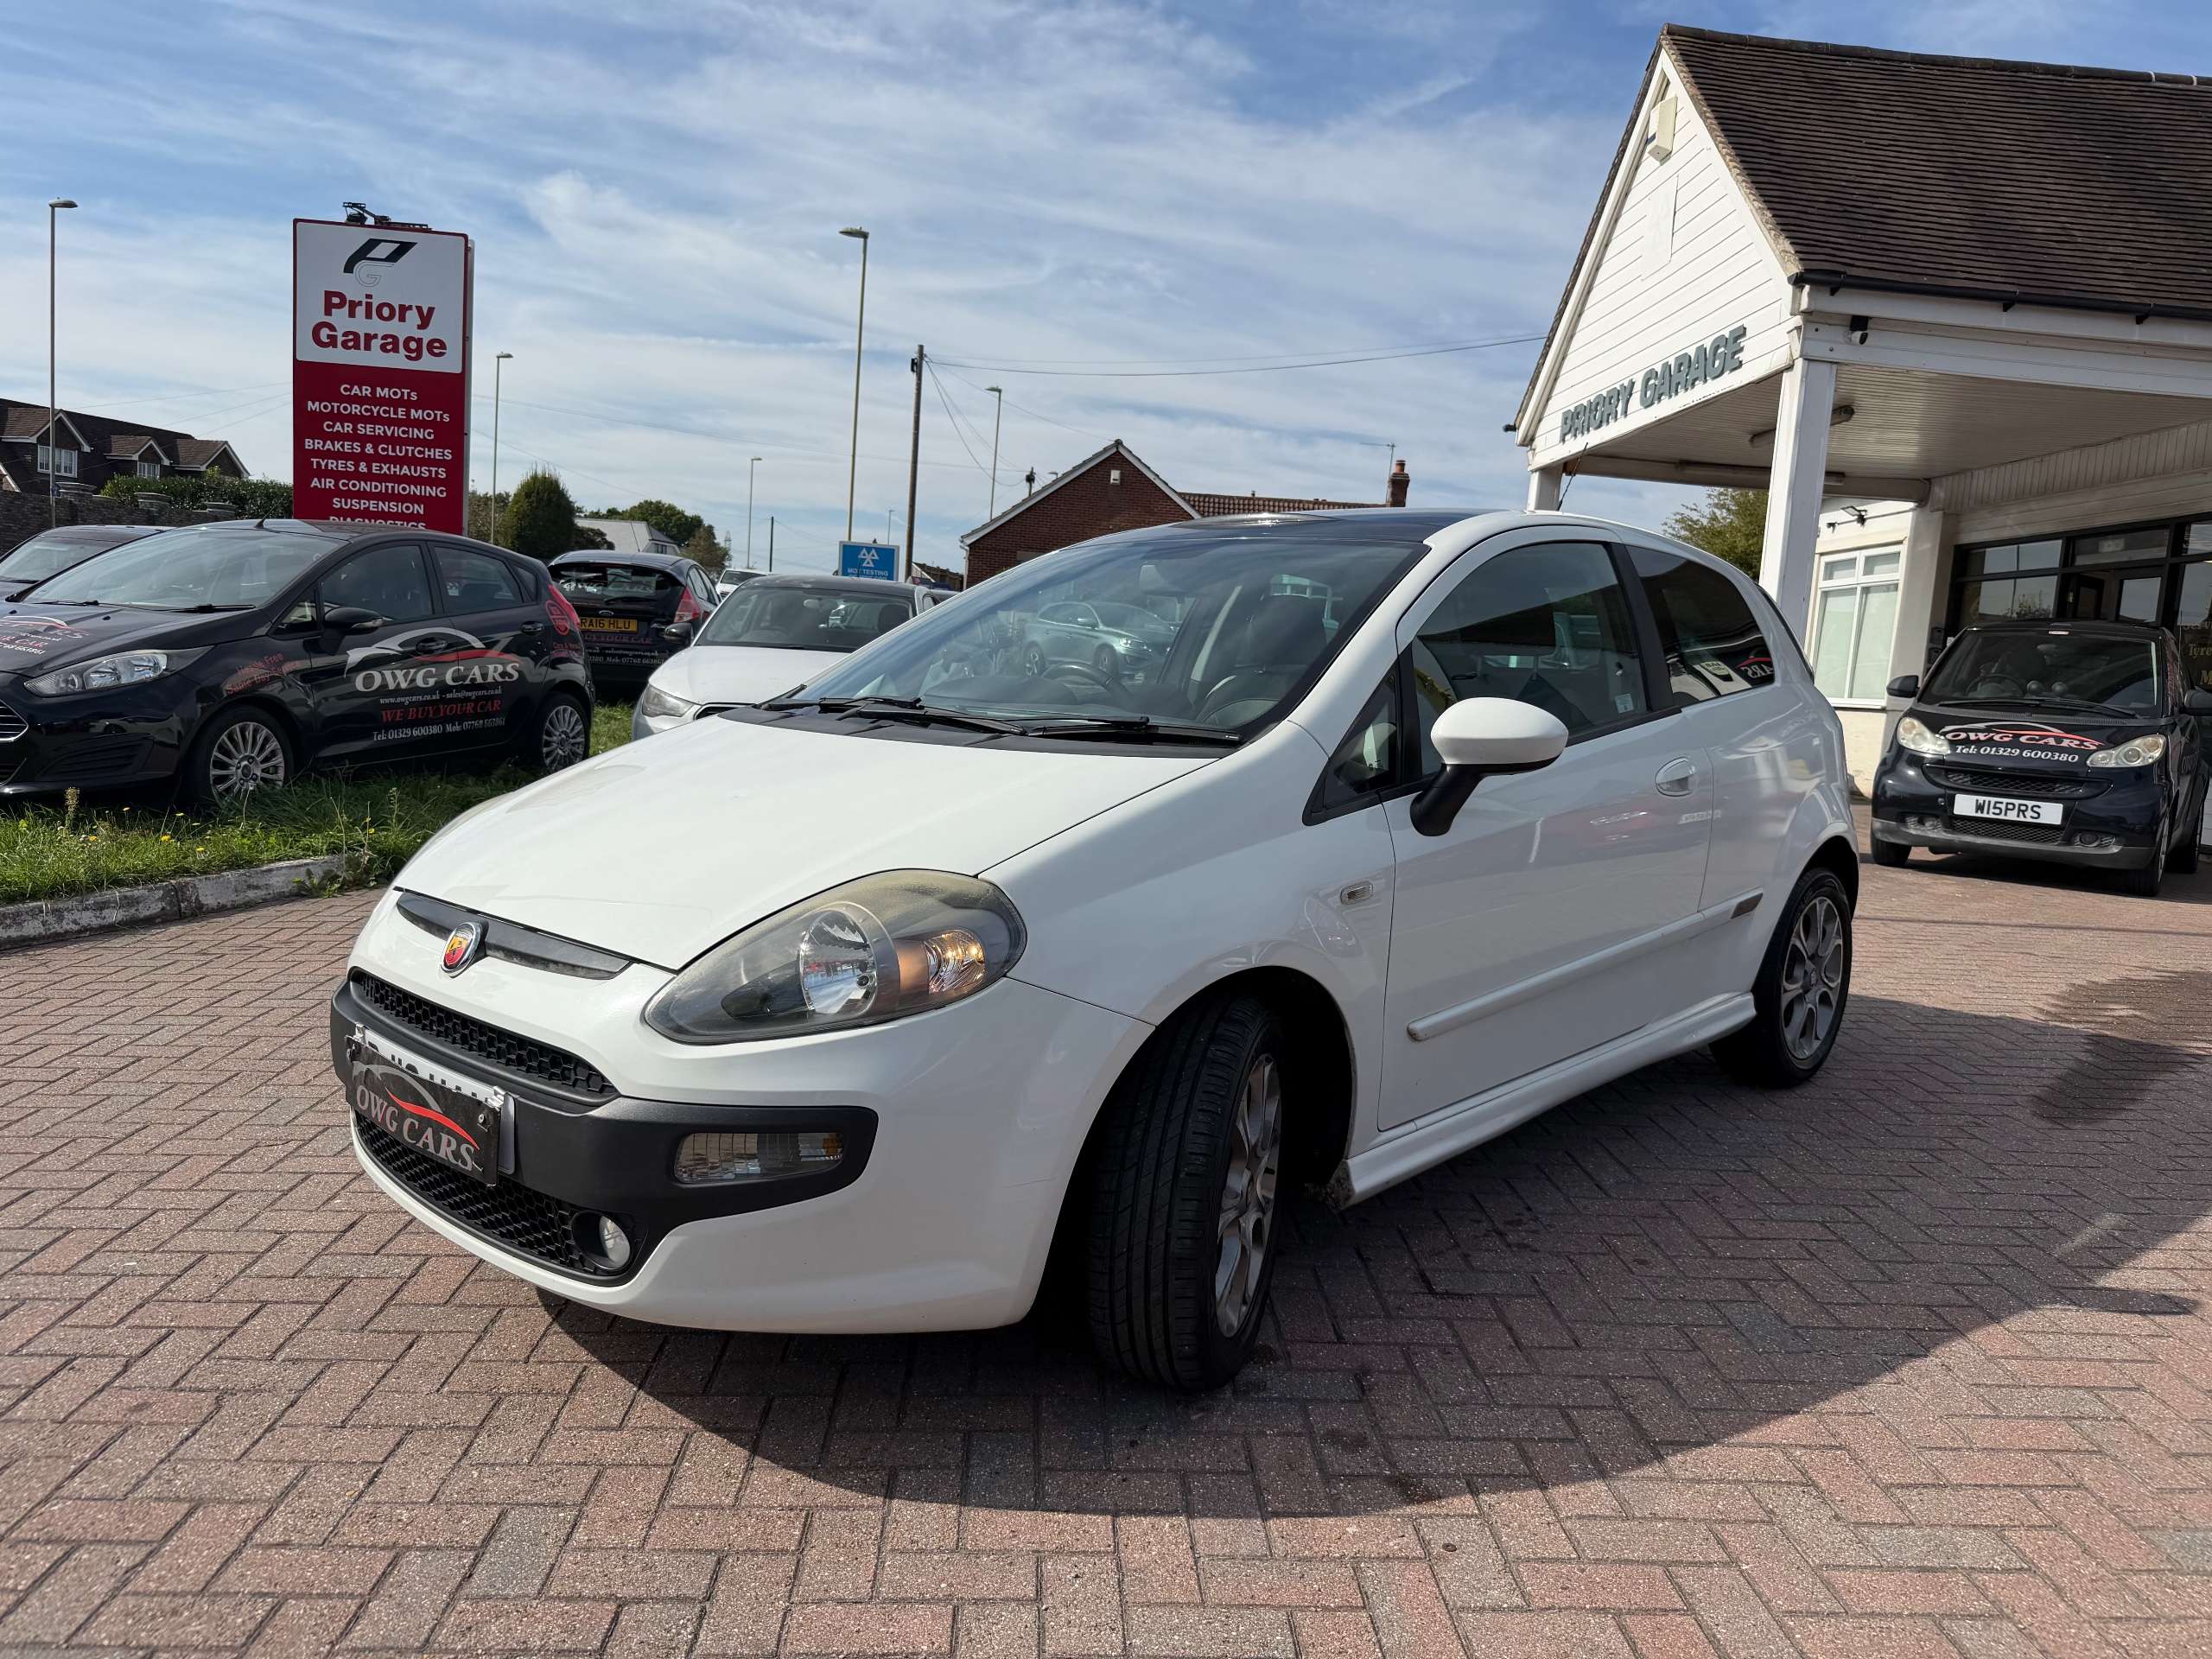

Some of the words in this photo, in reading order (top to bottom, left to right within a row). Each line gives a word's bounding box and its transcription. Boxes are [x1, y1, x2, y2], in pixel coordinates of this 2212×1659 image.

[324, 289, 435, 330] Priory
[312, 321, 448, 361] Garage
[340, 385, 372, 397] CAR
[376, 387, 418, 401] MOTs
[1559, 378, 1636, 444] PRIORY
[1639, 323, 1747, 409] GARAGE
[307, 401, 407, 419] MOTORCYCLE
[410, 409, 450, 423] MOTs
[323, 421, 353, 434] CAR
[357, 423, 435, 440] SERVICING
[304, 438, 361, 454] BRAKES
[365, 443, 374, 454] &
[378, 444, 453, 461] CLUTCHES
[310, 458, 355, 472] TYRES
[359, 462, 368, 473] &
[372, 462, 447, 479] EXHAUSTS
[310, 477, 335, 489] AIR
[339, 480, 447, 498] CONDITIONING
[333, 498, 424, 515] SUSPENSION
[863, 569, 889, 577] TESTING
[581, 617, 605, 629] RA16
[608, 619, 632, 630] HLU
[355, 668, 438, 692] OWG
[445, 663, 520, 686] CARS
[381, 709, 404, 722] WE
[408, 705, 436, 720] BUY
[439, 702, 474, 717] YOUR
[476, 699, 502, 712] CAR
[373, 729, 387, 741] Tel:
[388, 728, 411, 740] 01329
[412, 724, 443, 736] 600380
[1945, 732, 2014, 742] OWG
[2018, 735, 2098, 750] CARS
[1955, 745, 1977, 754] Tel:
[1980, 747, 2019, 757] 01329
[2022, 749, 2079, 762] 600380
[1974, 798, 2042, 820] W15PRS
[356, 1084, 398, 1133] OWG
[403, 1117, 475, 1171] CARS
